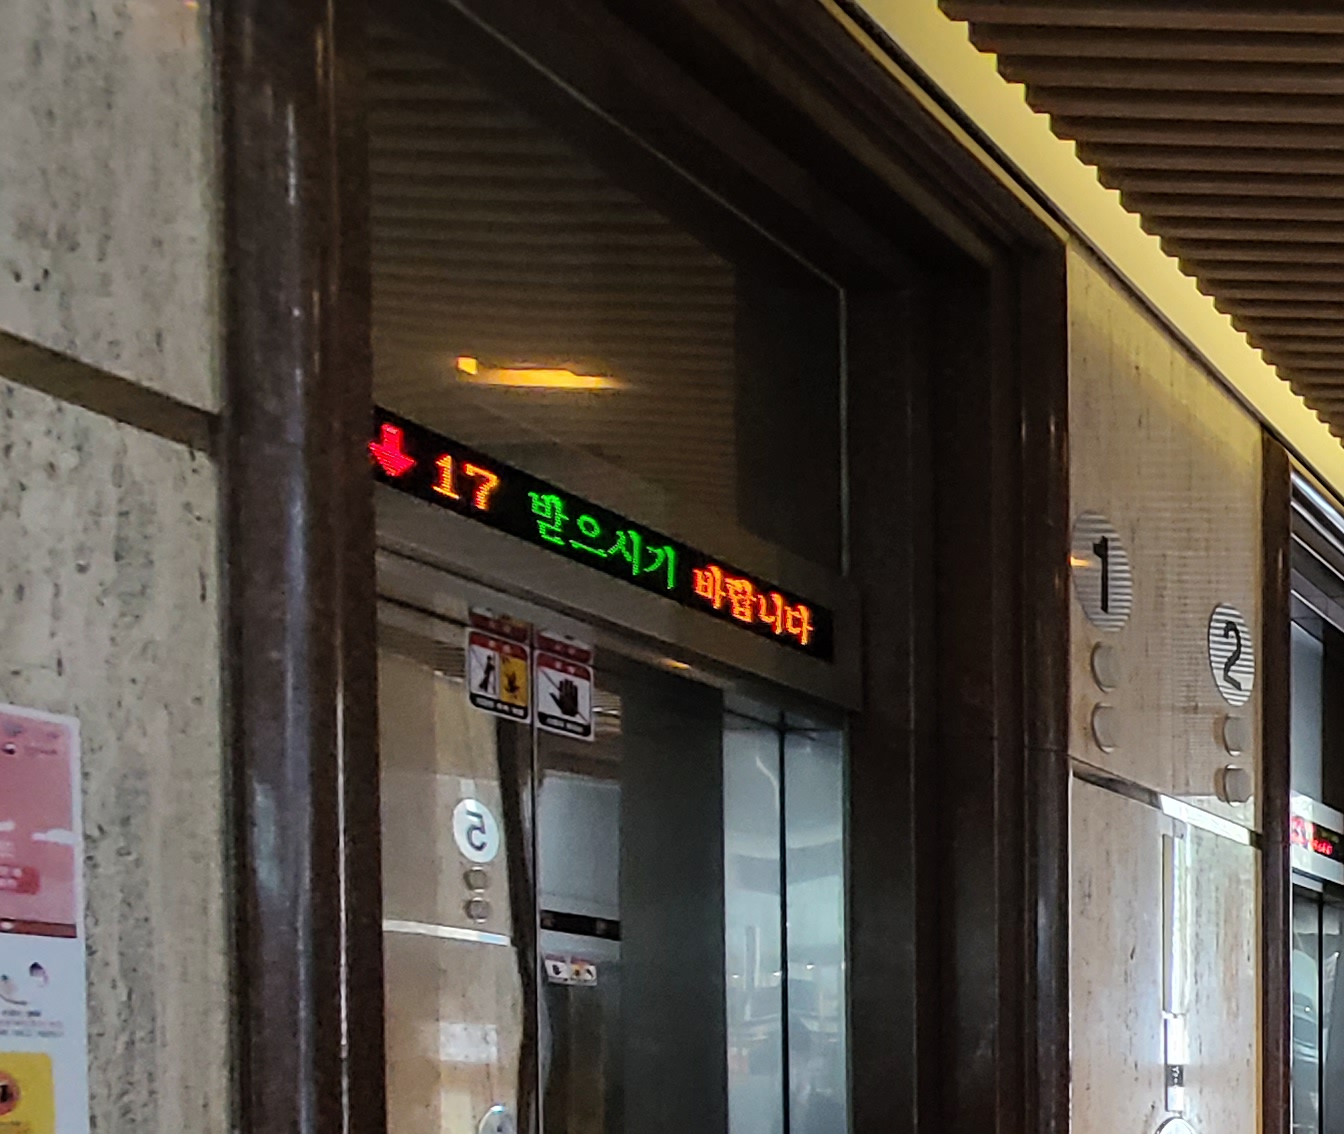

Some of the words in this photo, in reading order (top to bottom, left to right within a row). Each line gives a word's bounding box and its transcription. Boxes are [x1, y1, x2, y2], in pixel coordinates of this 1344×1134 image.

[431, 453, 499, 510] 17
[528, 491, 677, 590] 받으시기
[693, 565, 814, 646] 바랍니다
[1093, 535, 1109, 615] 1
[1222, 620, 1243, 692] 2
